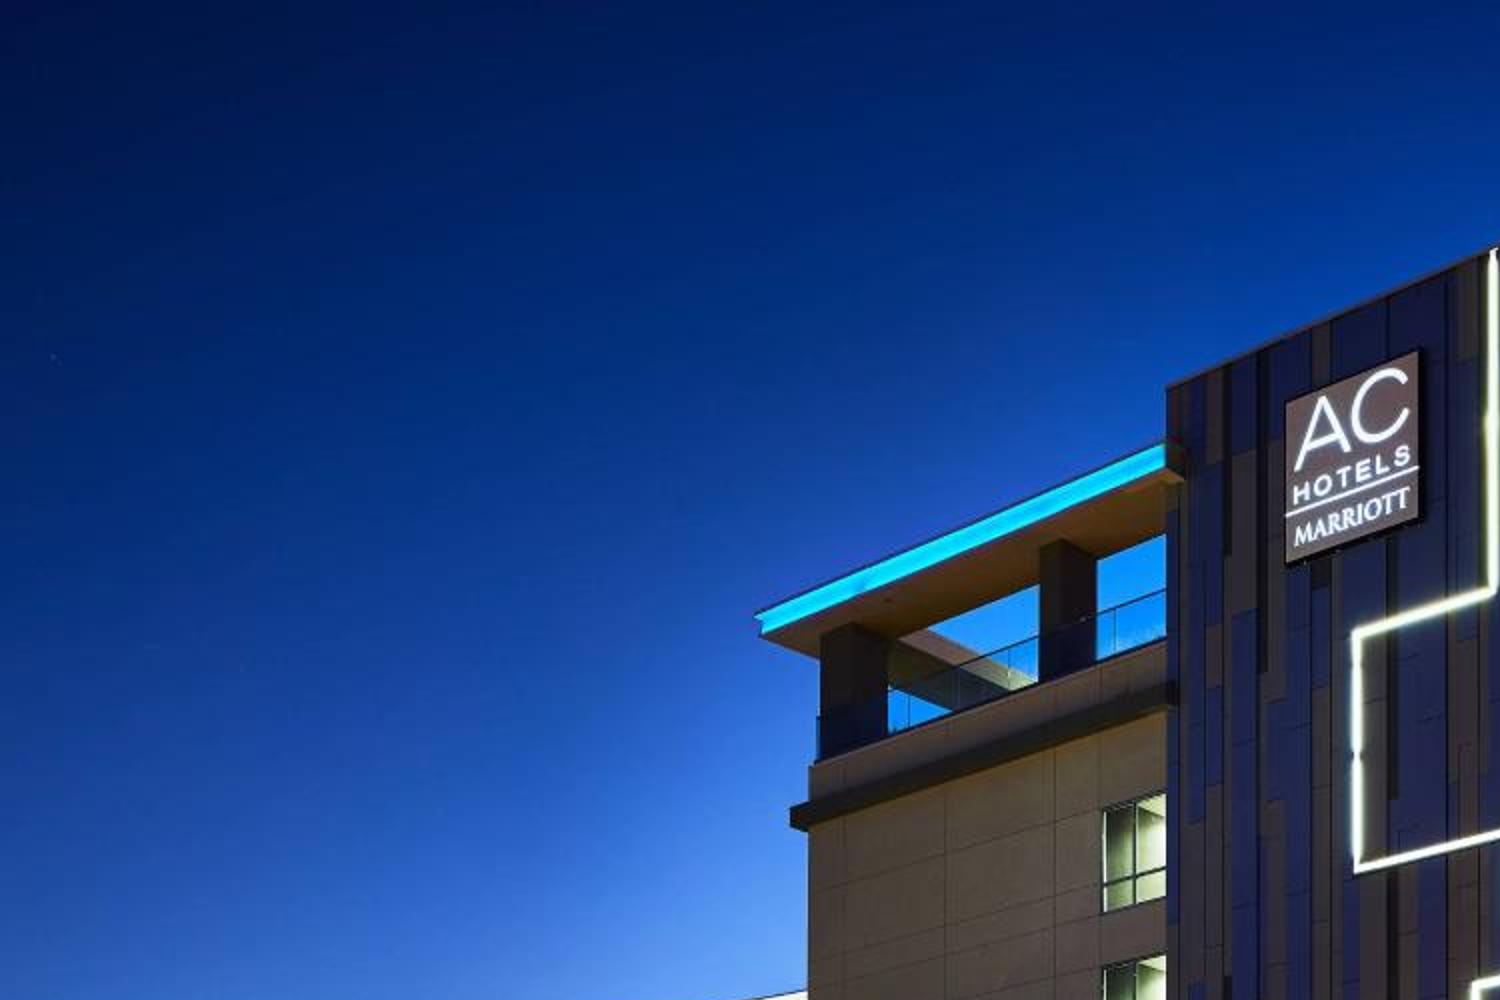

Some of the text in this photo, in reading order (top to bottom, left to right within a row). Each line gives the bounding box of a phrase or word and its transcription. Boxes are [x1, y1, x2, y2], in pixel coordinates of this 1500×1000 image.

[1294, 367, 1410, 472] AC
[1293, 445, 1411, 505] HOTELS
[1293, 486, 1411, 547] MARRIOTT
